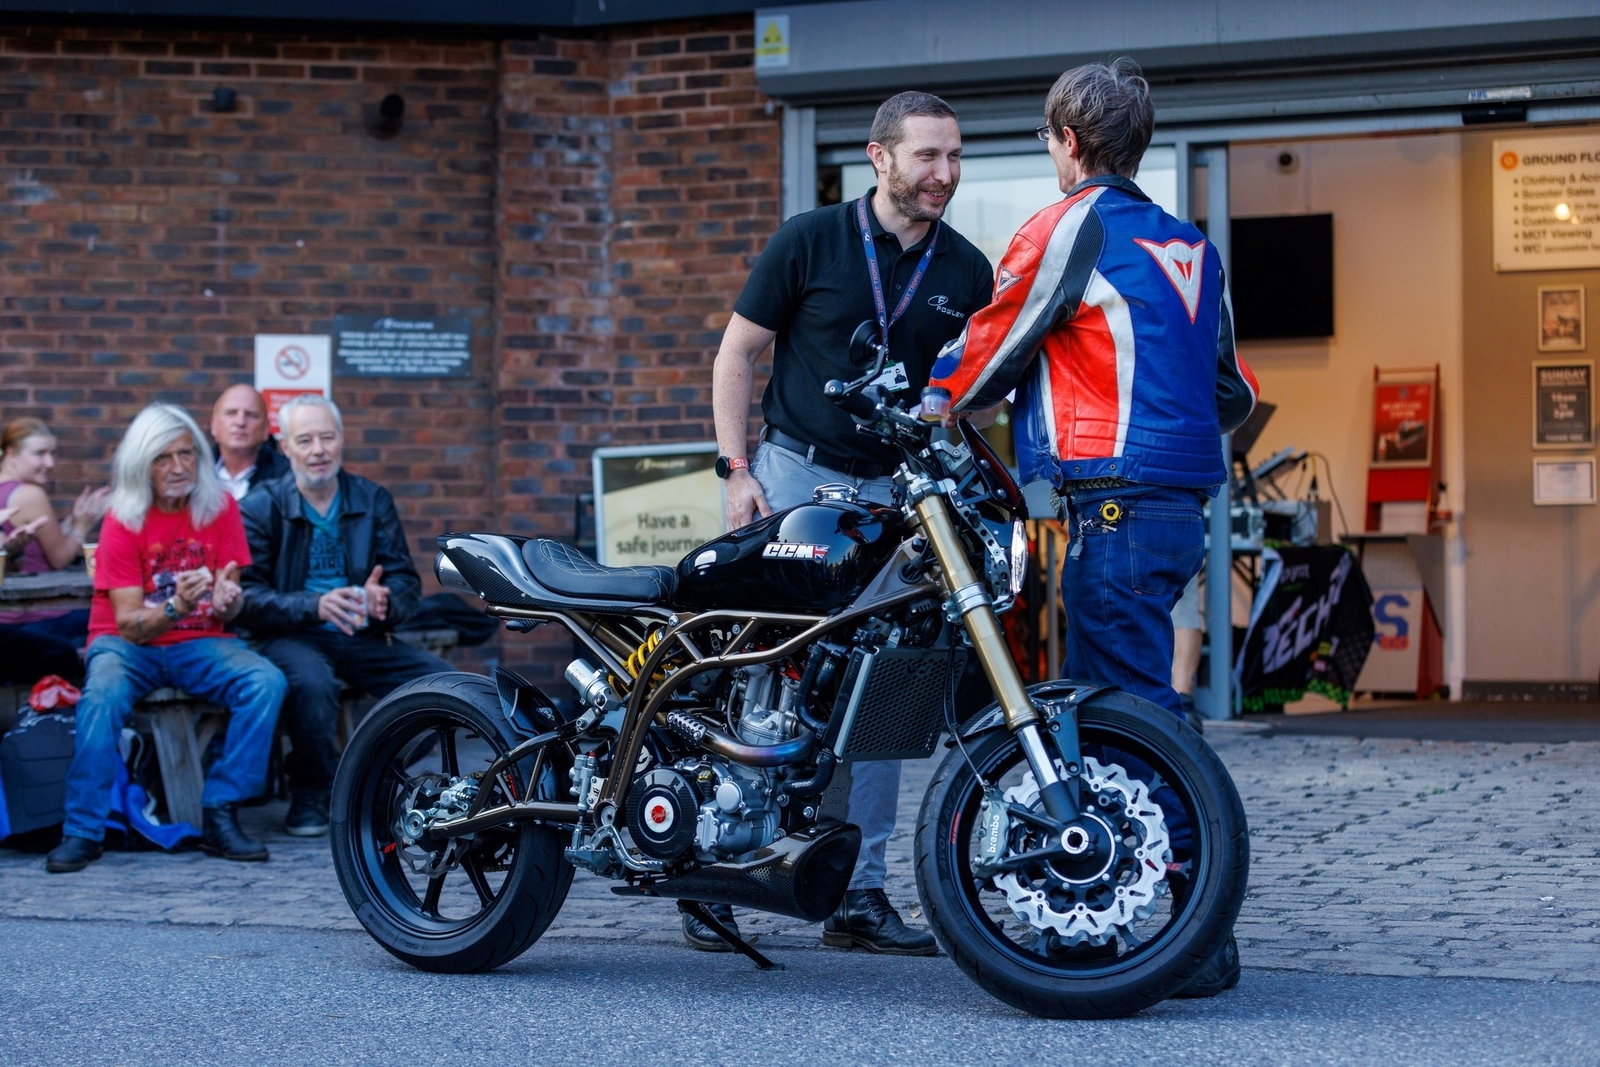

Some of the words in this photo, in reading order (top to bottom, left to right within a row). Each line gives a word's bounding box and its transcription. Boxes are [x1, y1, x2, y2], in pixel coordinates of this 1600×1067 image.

[1522, 153, 1577, 166] GROUND
[1522, 176, 1566, 185] Clothing
[637, 513, 677, 529] Have
[681, 515, 691, 528] a
[616, 536, 648, 554] safe
[650, 535, 710, 557] journe
[762, 544, 814, 559] CCM
[987, 814, 1000, 854] brembo
